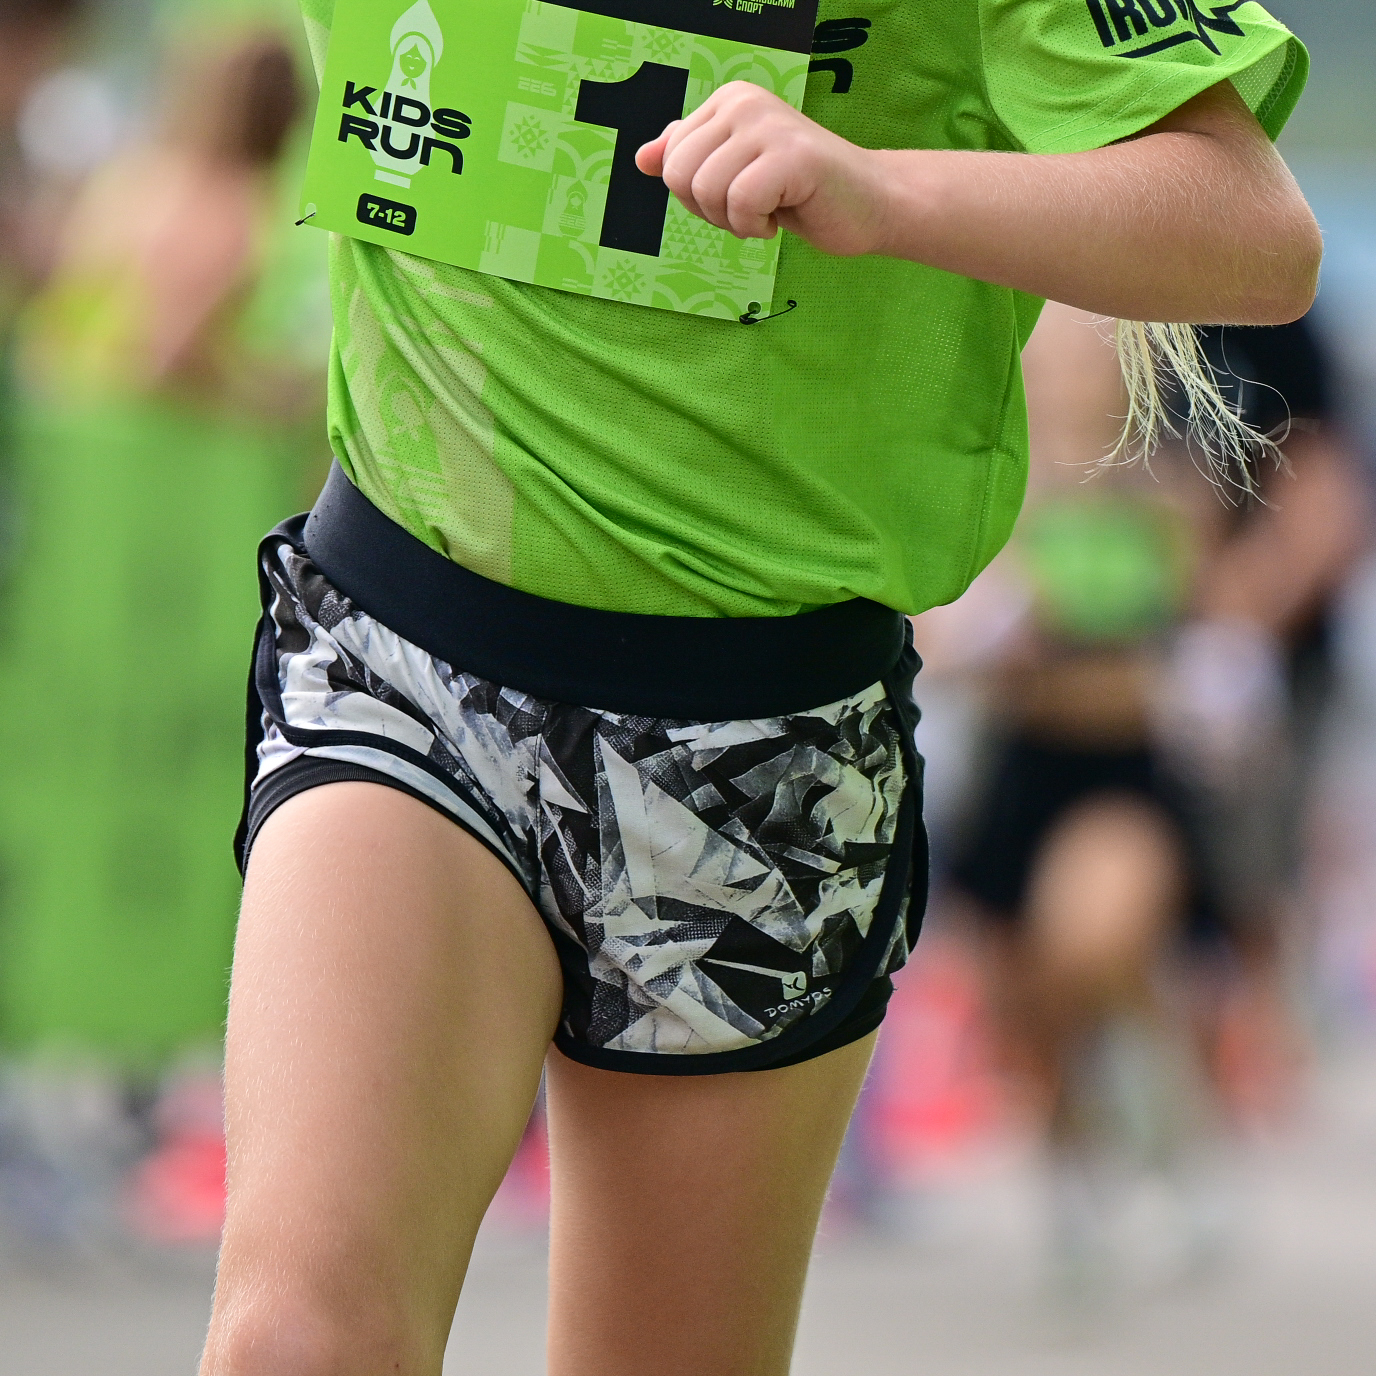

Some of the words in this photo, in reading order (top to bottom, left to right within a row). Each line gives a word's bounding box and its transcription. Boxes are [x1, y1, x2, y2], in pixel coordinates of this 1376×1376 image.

[735, 0, 764, 15] СПОРТ
[342, 80, 473, 140] KIDS
[574, 60, 690, 258] 1
[366, 202, 407, 228] 7-12
[764, 986, 832, 1018] DOMYOS
